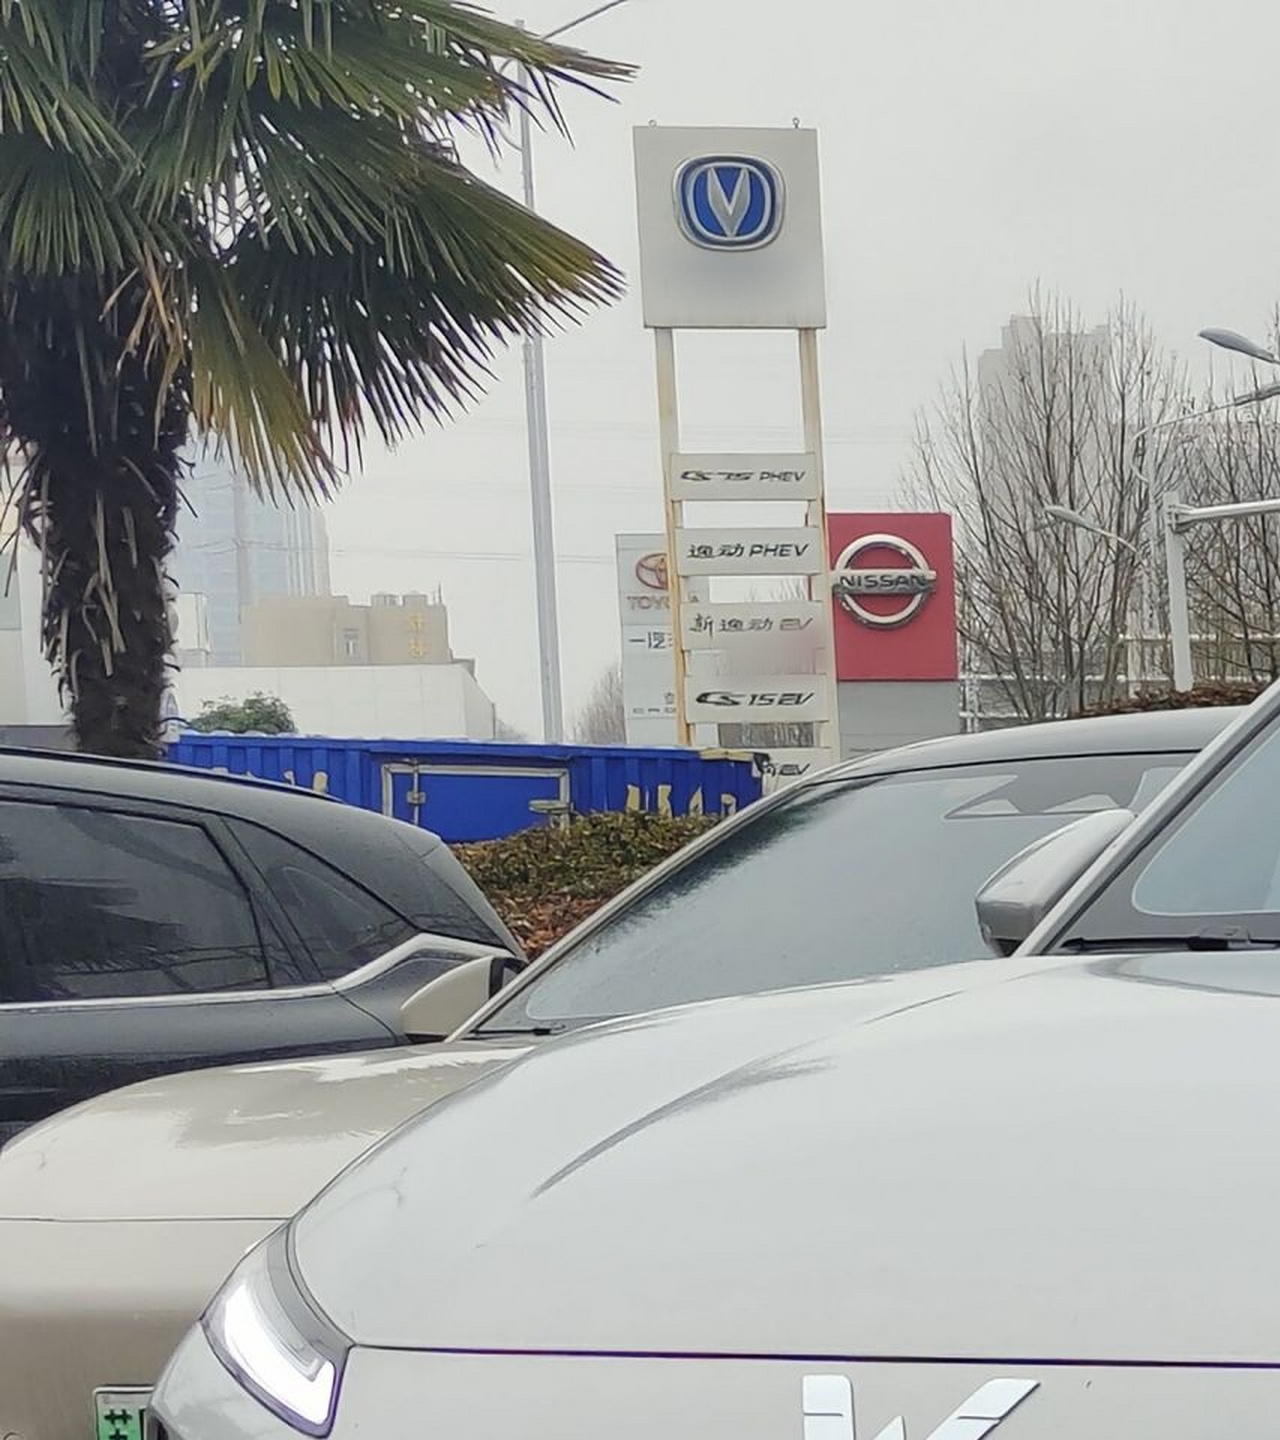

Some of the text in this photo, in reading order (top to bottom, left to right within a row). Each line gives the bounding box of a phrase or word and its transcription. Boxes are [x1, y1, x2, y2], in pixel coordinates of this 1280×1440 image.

[759, 471, 806, 481] PHEV
[749, 544, 809, 557] PHEV
[840, 575, 926, 588] NISSAN
[779, 618, 813, 631] EV
